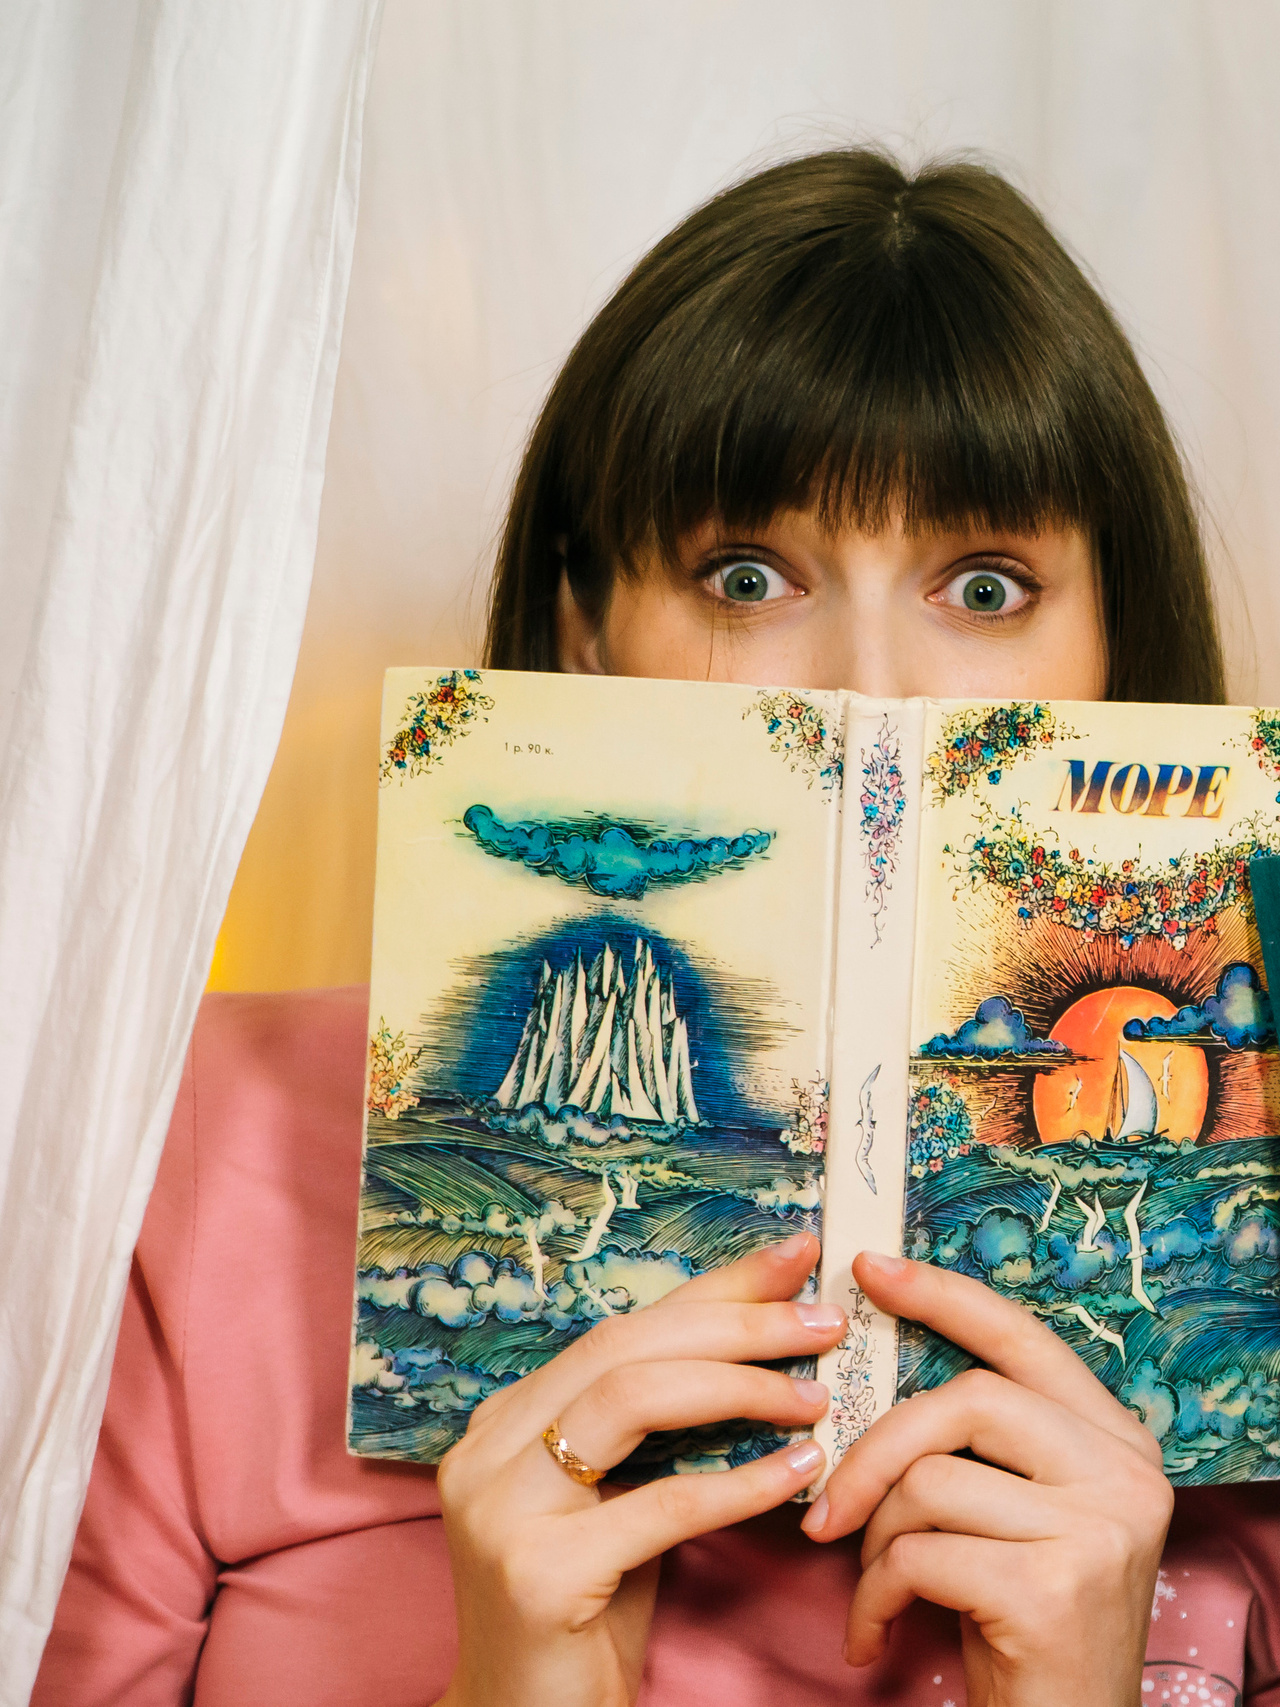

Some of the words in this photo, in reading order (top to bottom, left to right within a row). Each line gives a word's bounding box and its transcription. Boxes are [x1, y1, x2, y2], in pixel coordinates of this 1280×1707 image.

[513, 745, 523, 755] р.
[527, 743, 541, 754] 90
[1049, 759, 1232, 818] МОРЕ
